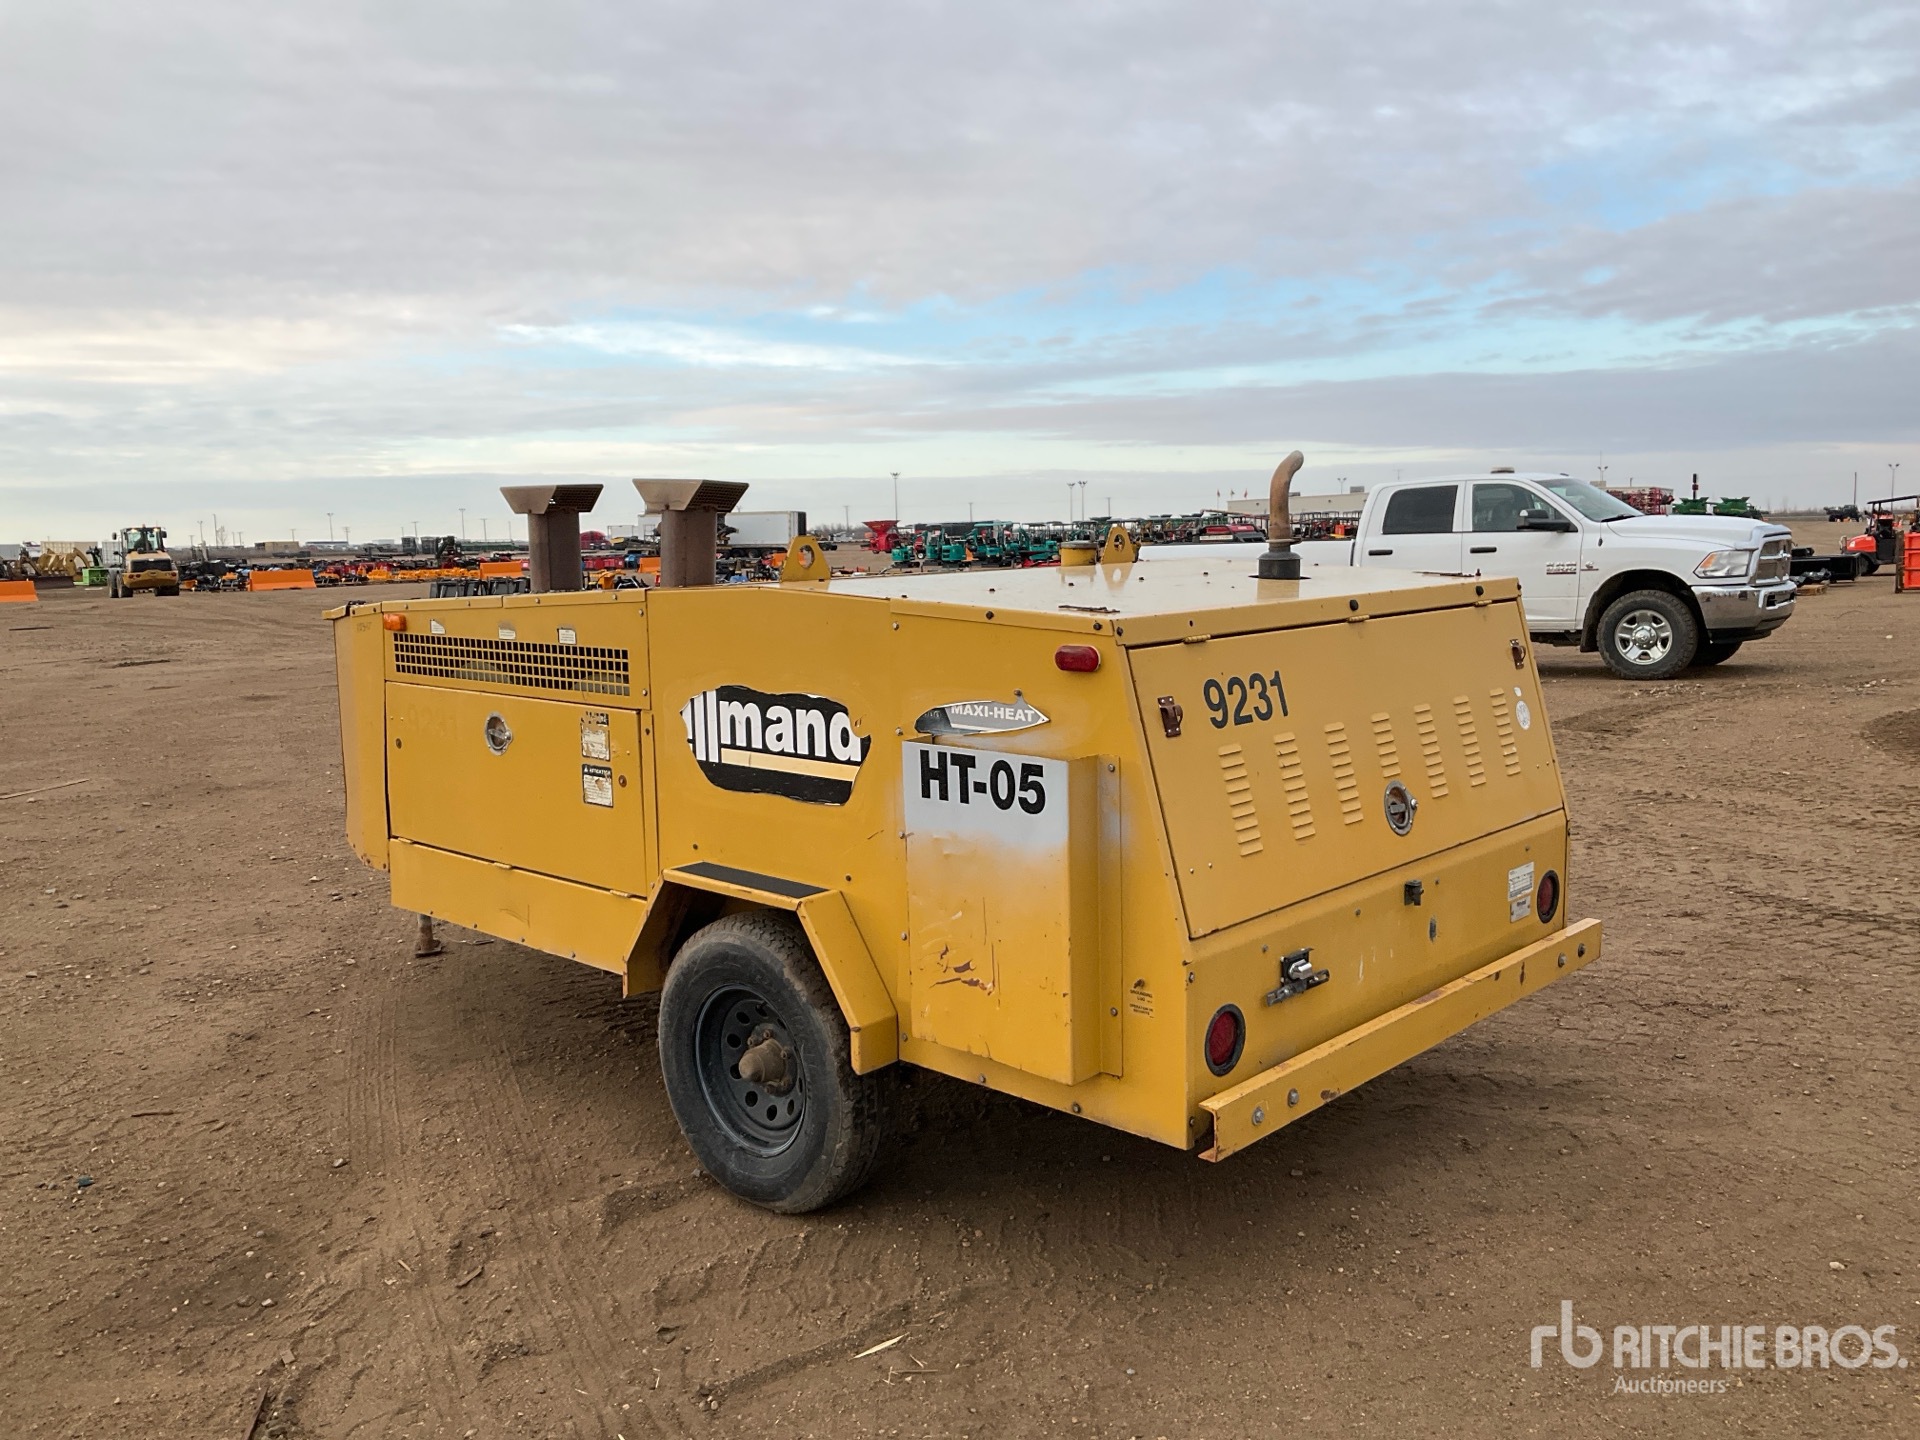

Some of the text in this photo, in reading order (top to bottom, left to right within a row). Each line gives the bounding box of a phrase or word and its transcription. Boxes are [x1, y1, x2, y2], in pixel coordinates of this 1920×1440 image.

[951, 703, 1035, 722] MAXI-HEAT
[1203, 670, 1289, 729] 9231
[919, 749, 1046, 815] HT-05
